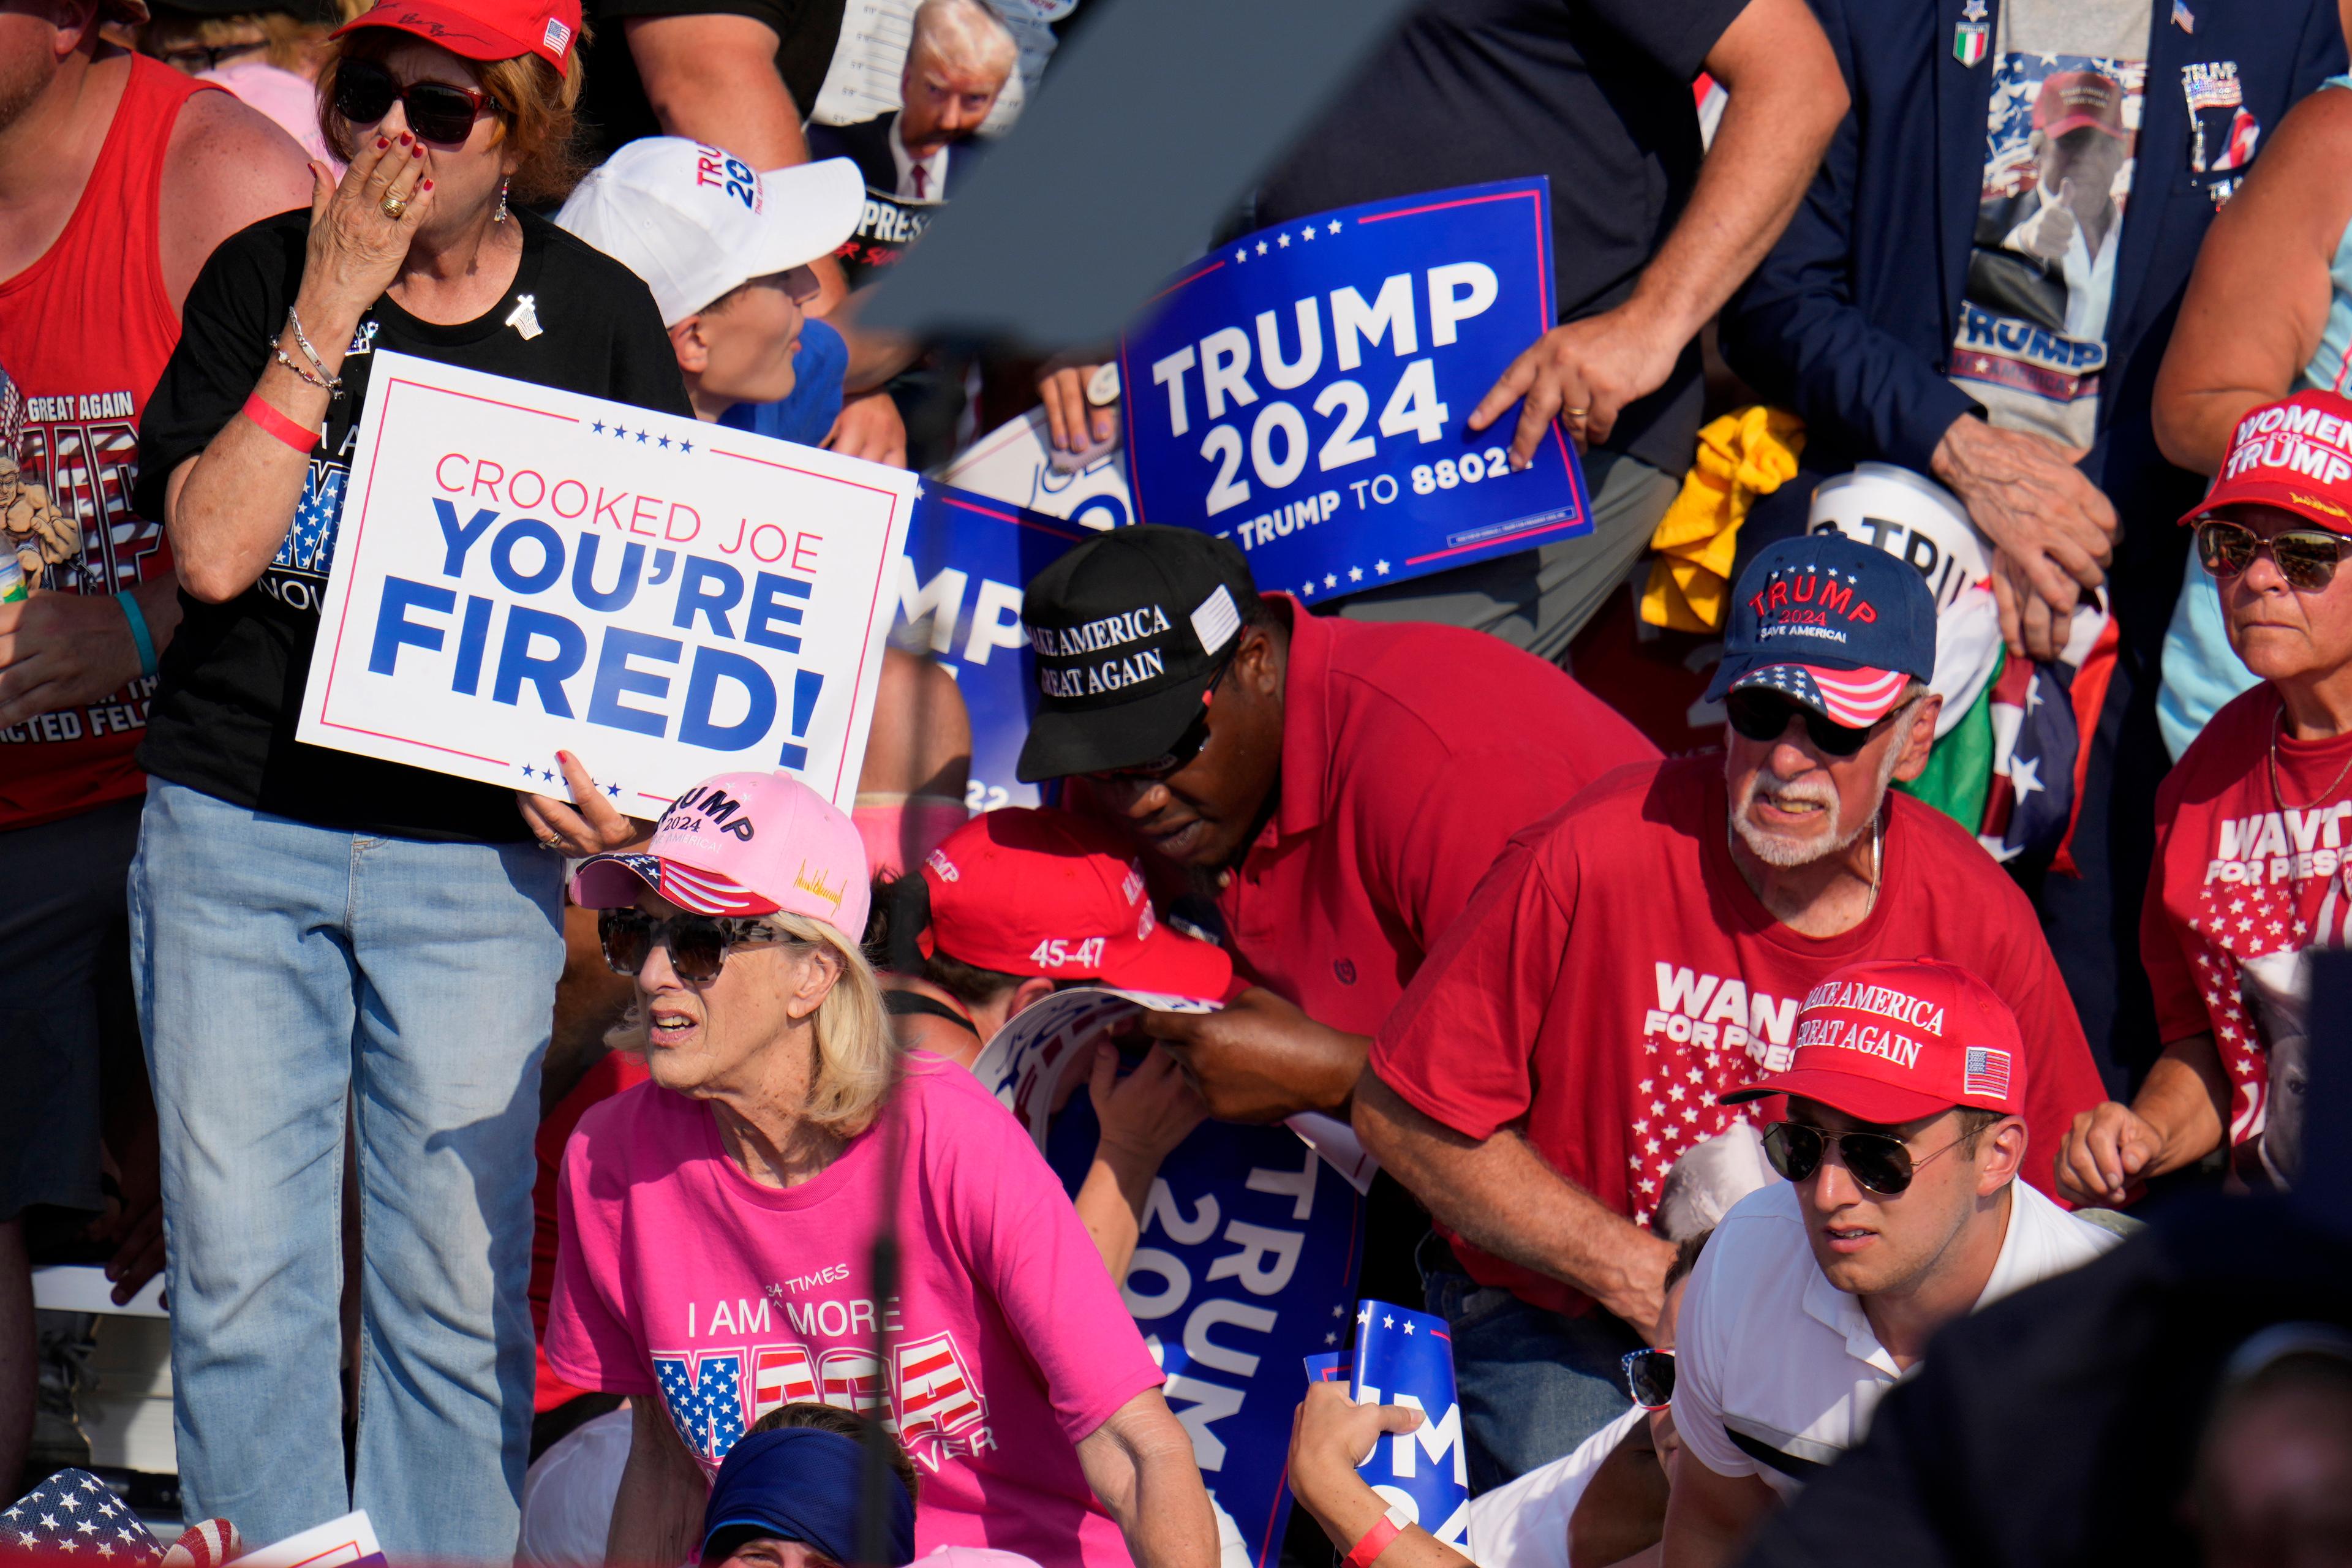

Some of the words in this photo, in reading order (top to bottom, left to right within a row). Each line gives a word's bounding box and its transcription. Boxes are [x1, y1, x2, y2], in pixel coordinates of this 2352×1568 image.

[1153, 262, 1498, 437] TRUMP
[28, 396, 75, 423] GREAT
[79, 390, 134, 421] AGAIN
[1200, 358, 1449, 516] 2024
[2270, 431, 2304, 443] FOR
[2226, 440, 2351, 484] TRUMP
[435, 453, 700, 542] CROOKED
[718, 518, 823, 573] JOE
[1238, 489, 1341, 550] TRUMP
[1349, 474, 1398, 510] TO
[1411, 445, 1533, 495] 8802
[431, 497, 812, 654] YOU'RE
[1748, 575, 1877, 624] TRUMP
[1778, 609, 1826, 627] 2024
[1059, 604, 1171, 657] AMERICA
[1761, 625, 1787, 638] SAVE
[1789, 625, 1847, 644] AMERICA!
[368, 575, 824, 771] FIRED!
[1088, 647, 1164, 695] AGAIN
[662, 816, 703, 832] 2024
[2204, 859, 2264, 886] FOR
[1030, 937, 1105, 968] 45-47
[1644, 1009, 1719, 1050] FOR
[1834, 982, 1944, 1036] AMERICA
[1796, 1019, 1845, 1050] GREAT
[1838, 1023, 1923, 1069] AGAIN
[766, 1283, 783, 1298] 34
[785, 1263, 850, 1294] TIMES
[688, 1302, 695, 1338] I
[708, 1298, 771, 1336] AM
[786, 1297, 904, 1338] MORE
